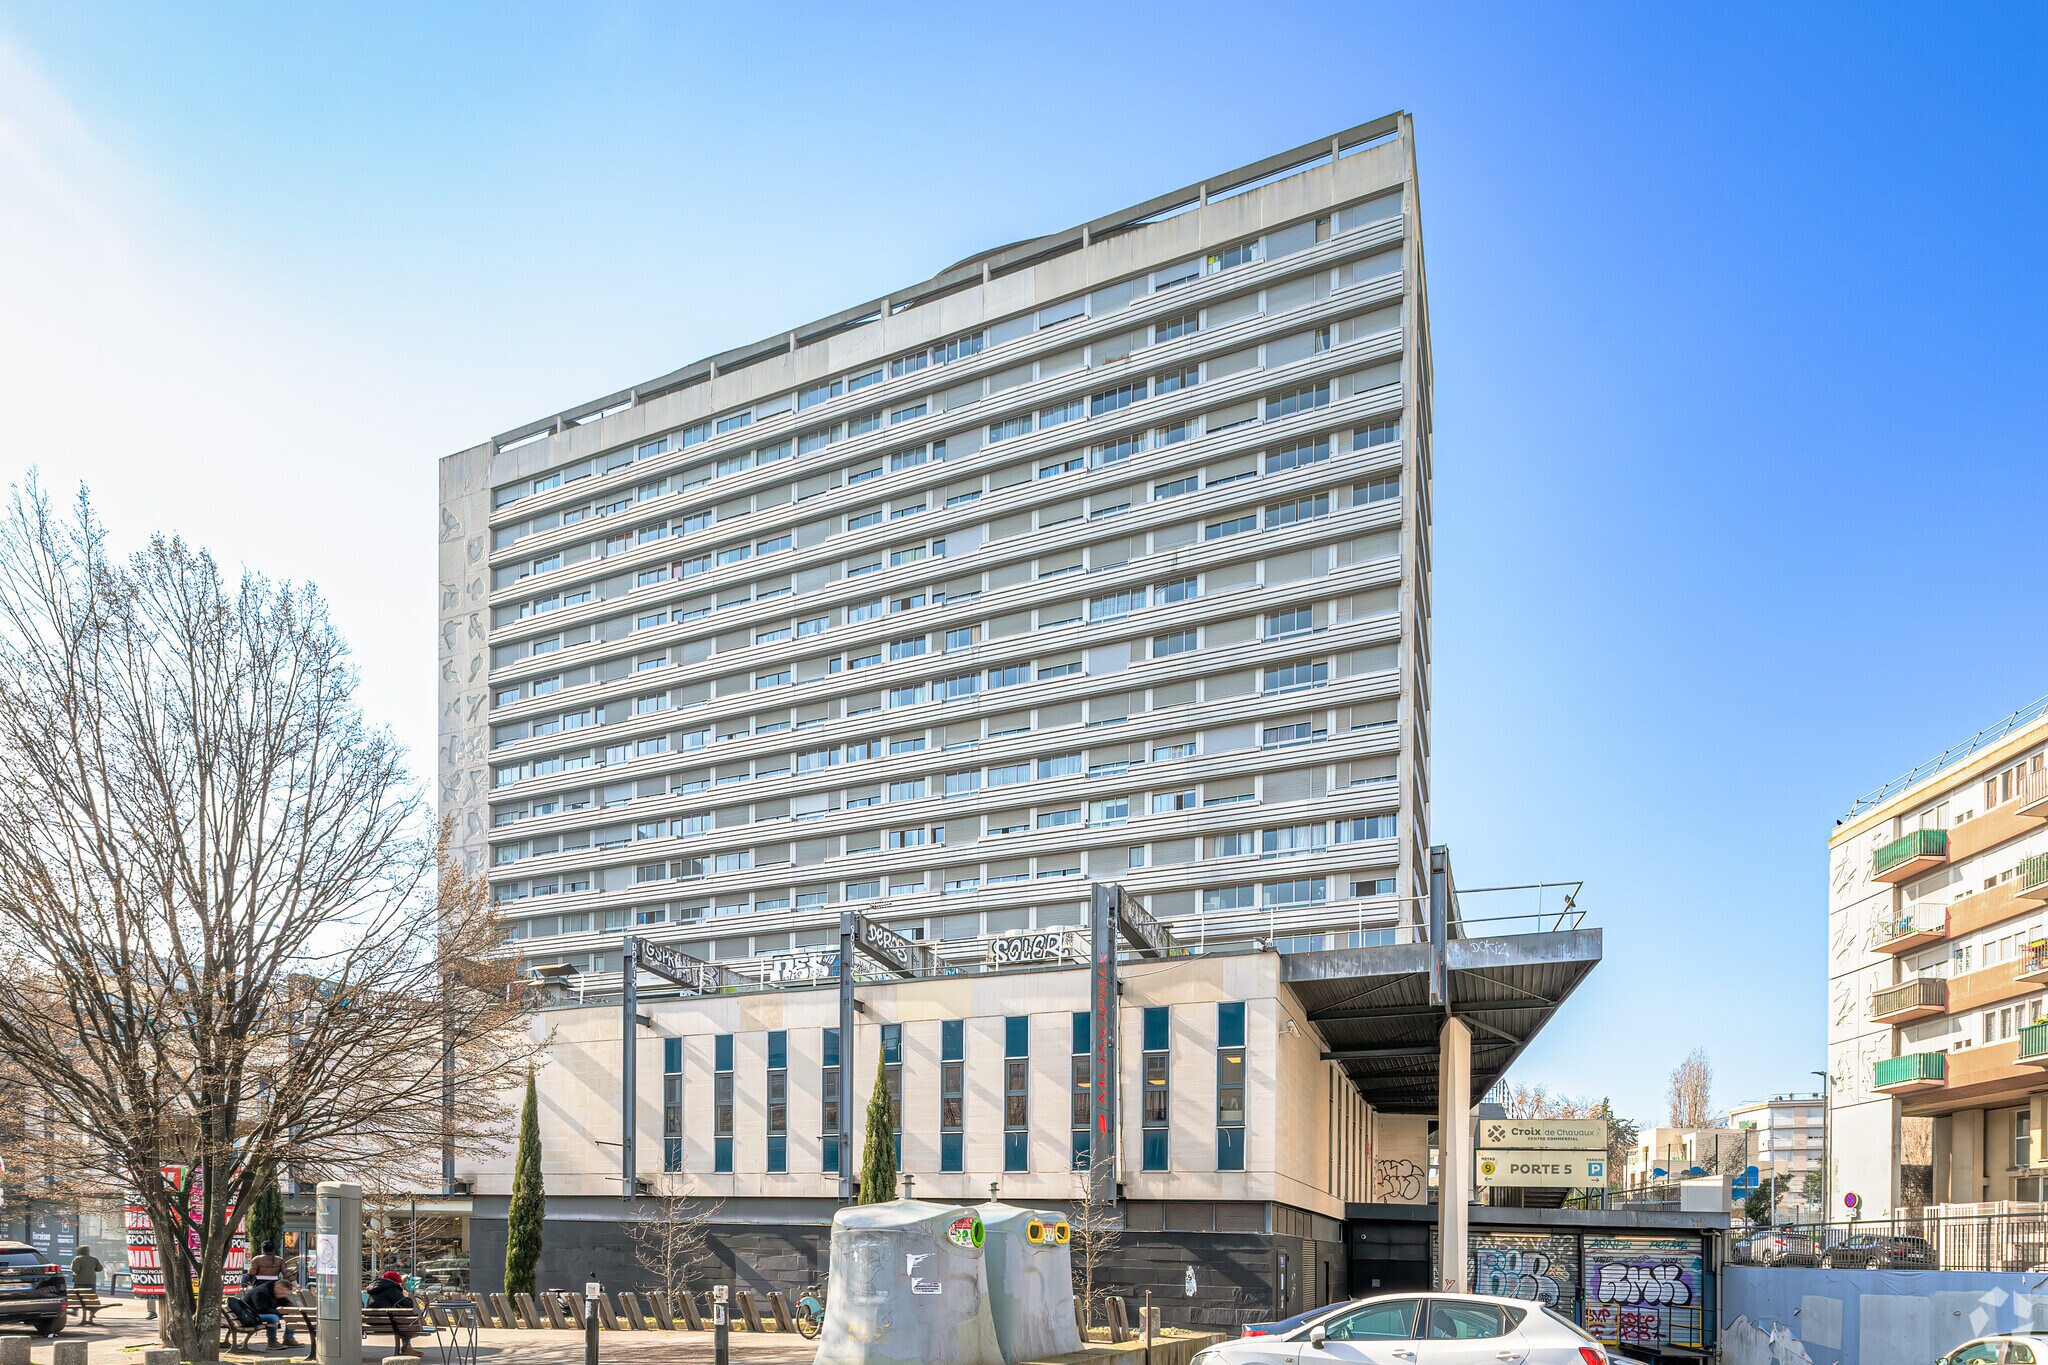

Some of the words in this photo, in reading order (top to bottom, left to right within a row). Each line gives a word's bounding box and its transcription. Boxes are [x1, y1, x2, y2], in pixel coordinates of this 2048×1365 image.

[1098, 952, 1108, 1104] MONOPRIX
[1511, 1127, 1541, 1136] Croix
[1544, 1128, 1555, 1136] de
[1485, 1164, 1492, 1173] 9
[1510, 1164, 1560, 1175] PORTE
[1564, 1164, 1572, 1175] 5
[1591, 1164, 1600, 1174] P
